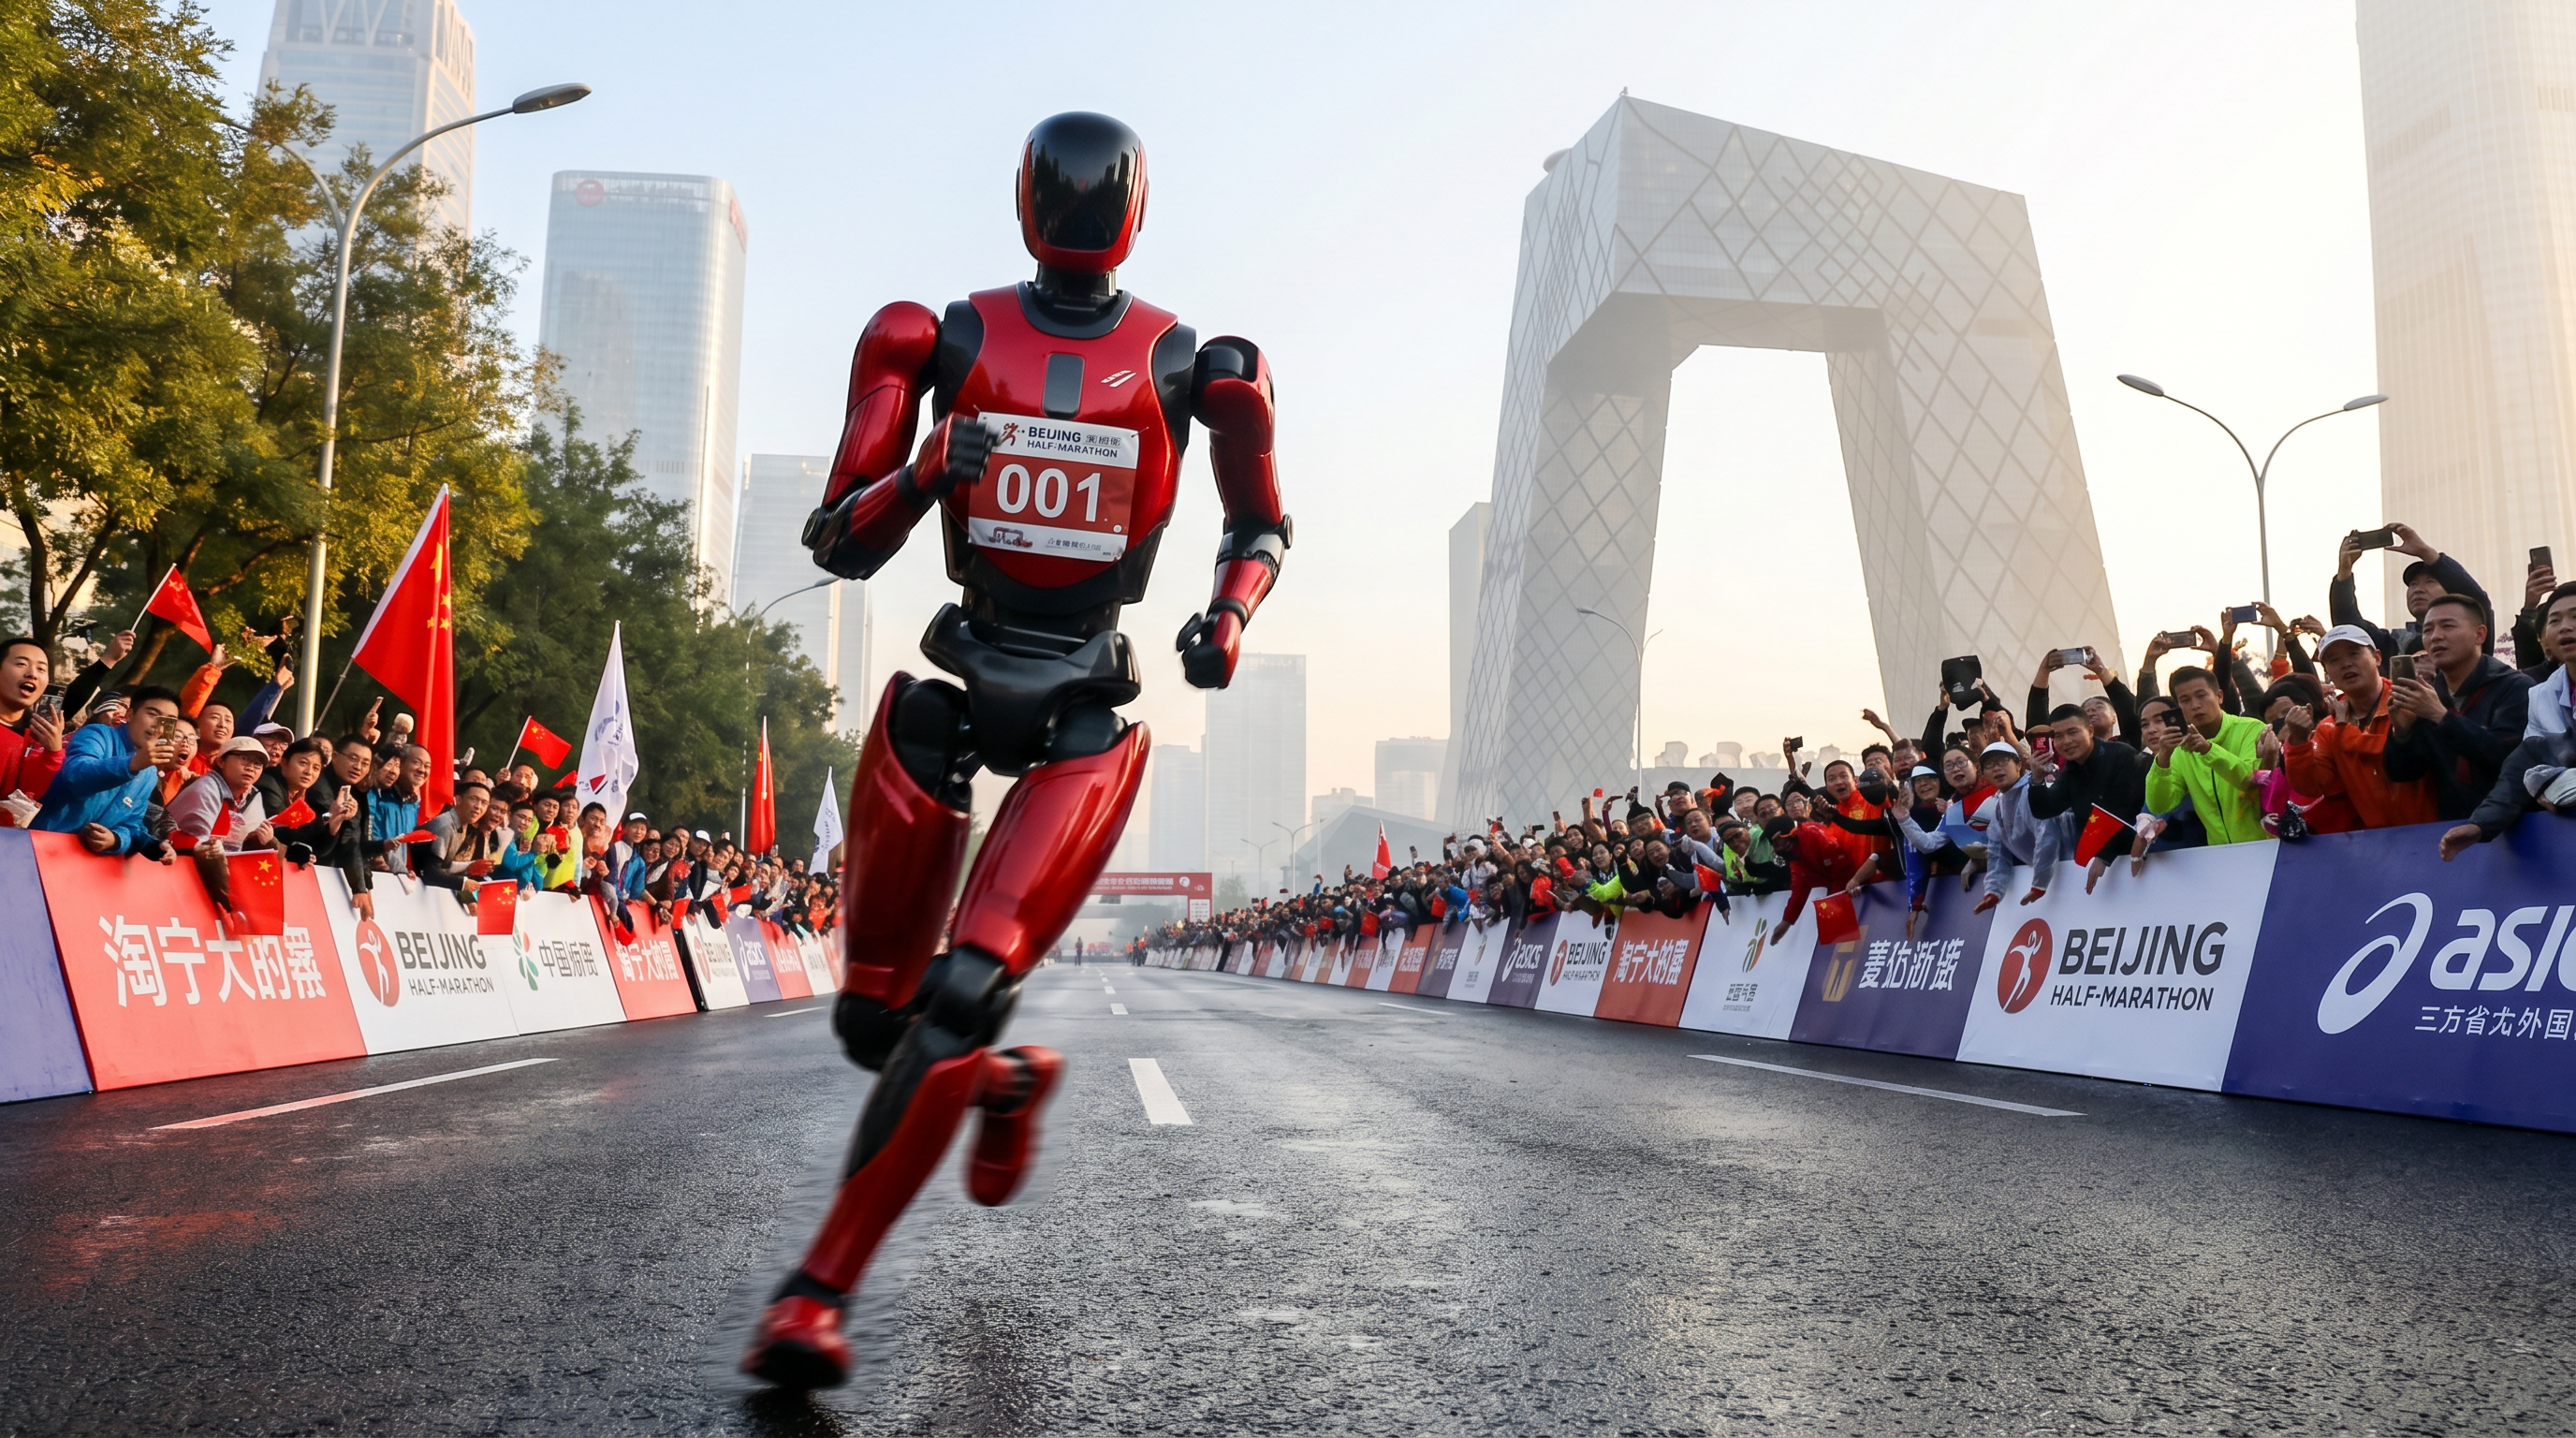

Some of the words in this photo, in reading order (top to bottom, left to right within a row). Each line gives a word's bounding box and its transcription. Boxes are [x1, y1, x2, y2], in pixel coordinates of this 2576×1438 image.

[1028, 426, 1081, 443] BEIJING
[996, 463, 1102, 522] 001
[394, 931, 487, 970] BEIJING
[1566, 941, 1608, 965] BEIJING
[2058, 921, 2229, 976] BEIJING
[2430, 904, 2576, 992] asi
[408, 976, 494, 996] HALF-MARATHON
[2050, 984, 2215, 1011] HALF-MARATHON
